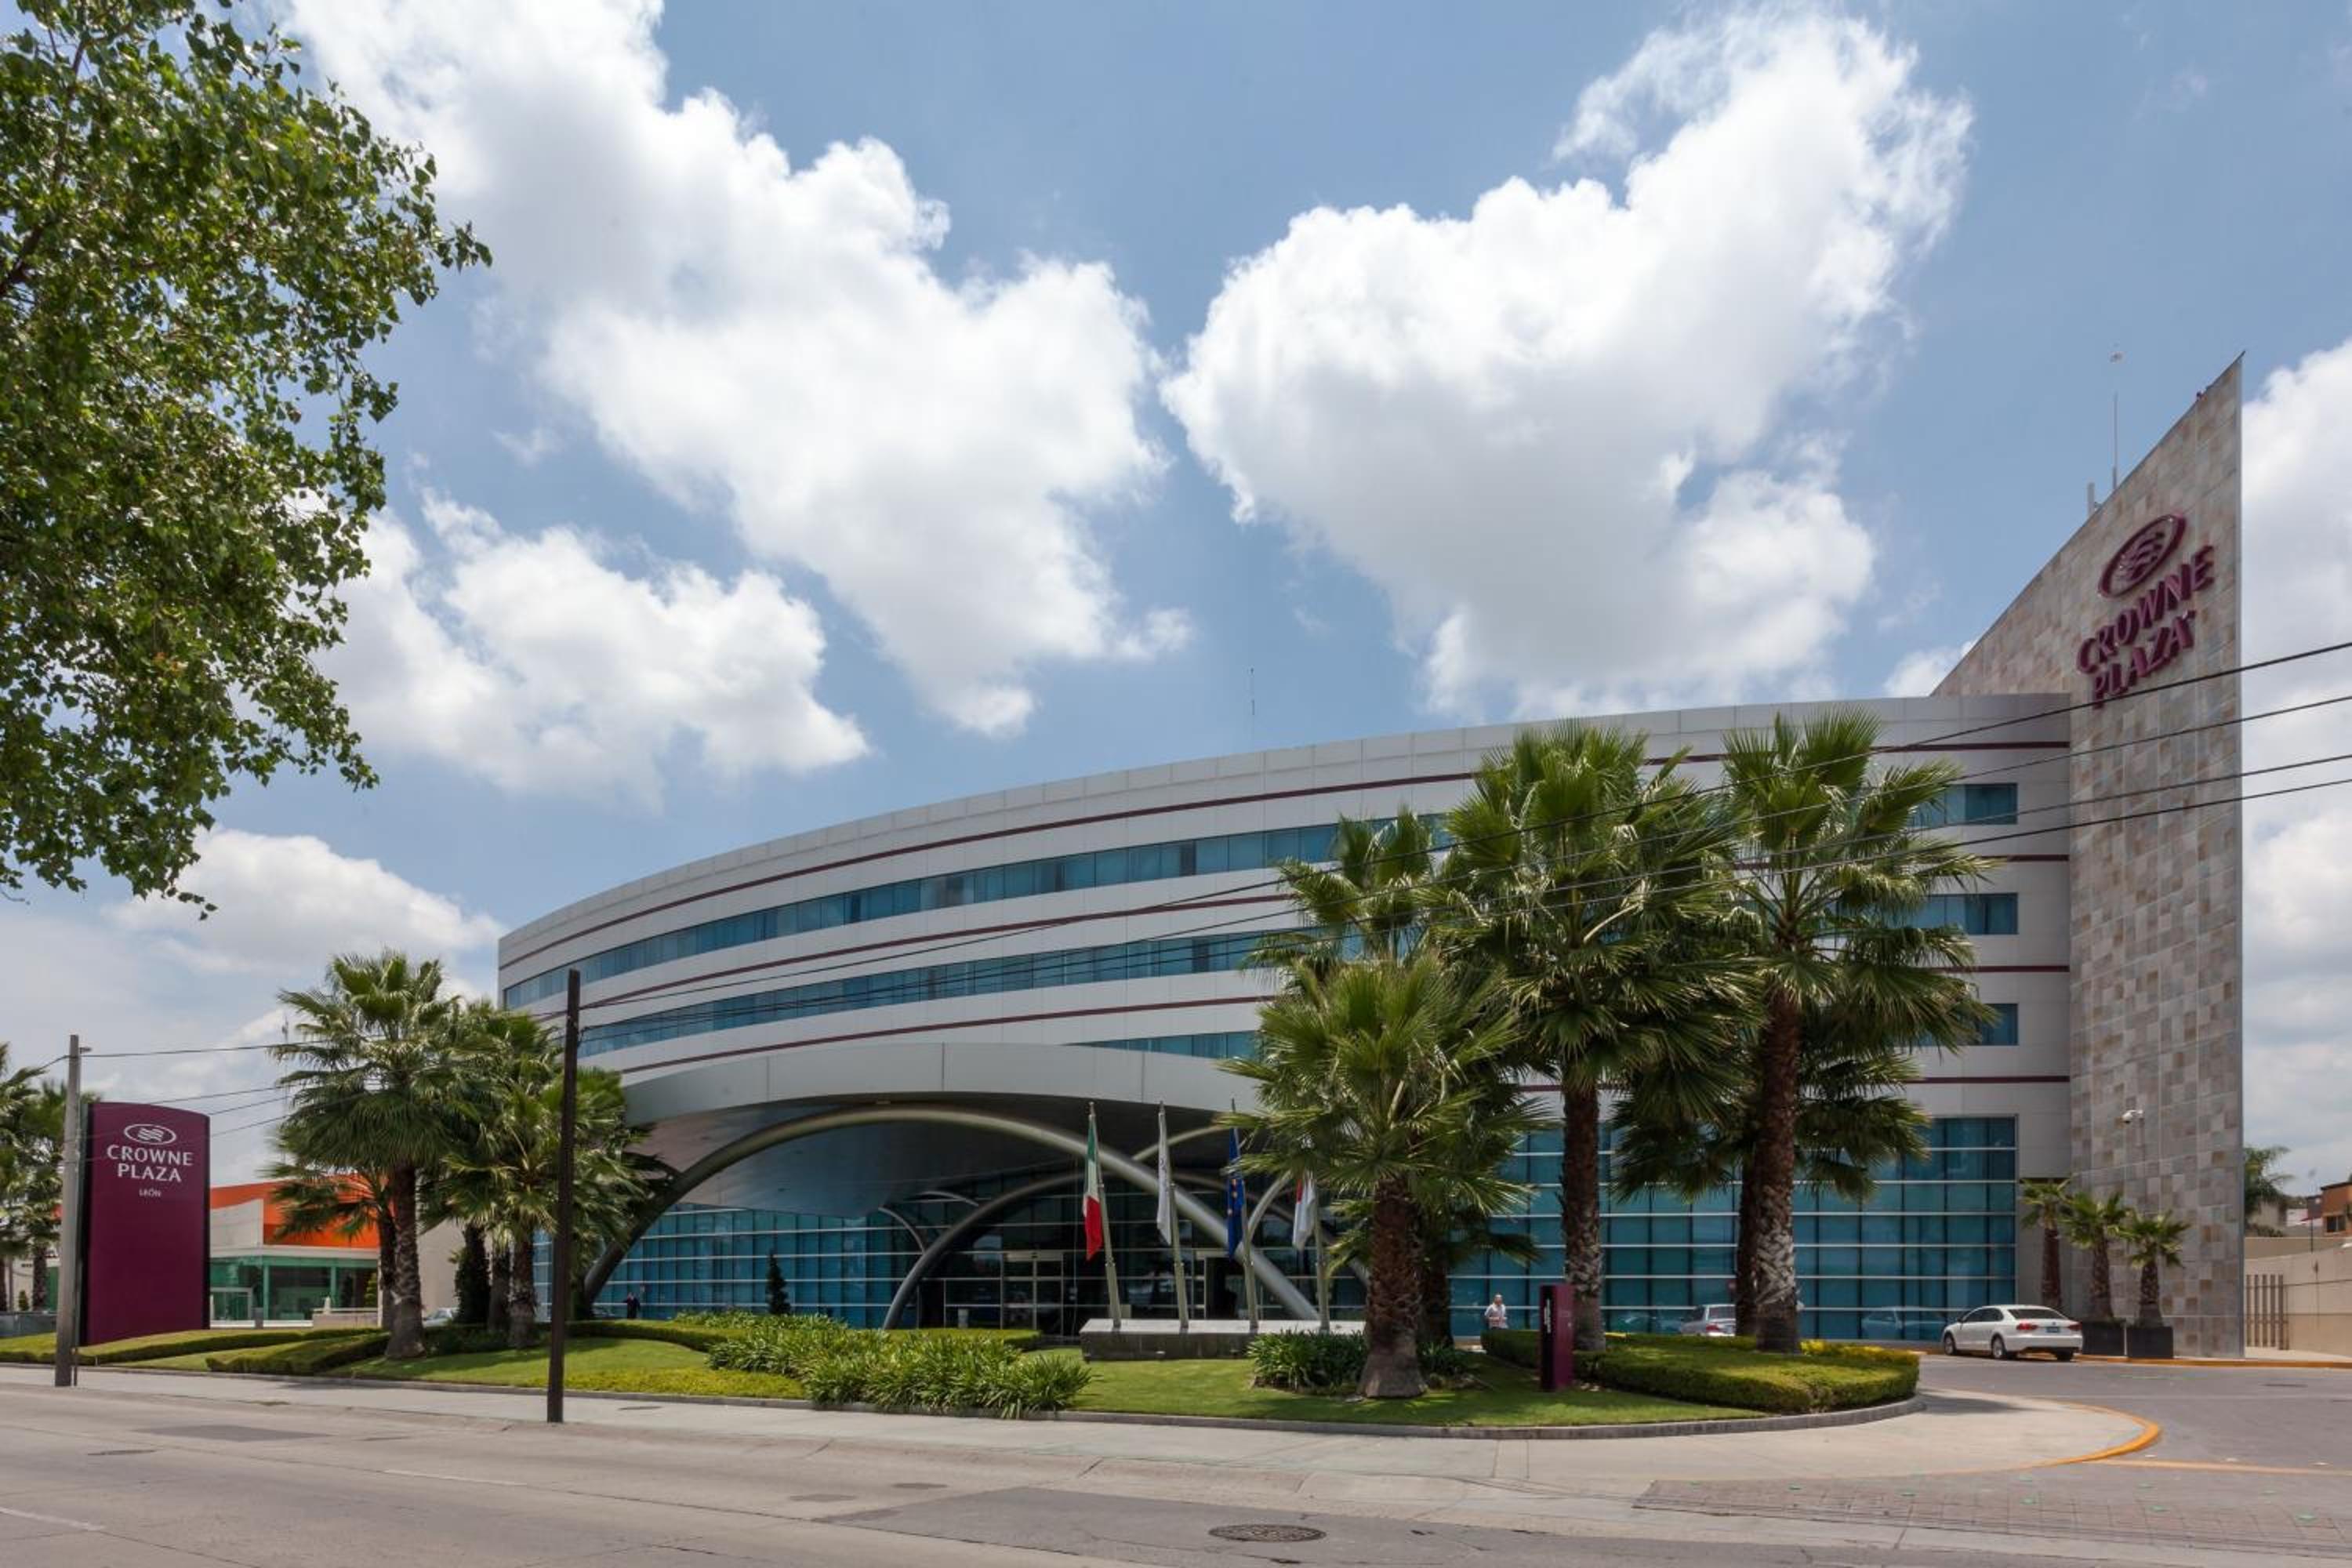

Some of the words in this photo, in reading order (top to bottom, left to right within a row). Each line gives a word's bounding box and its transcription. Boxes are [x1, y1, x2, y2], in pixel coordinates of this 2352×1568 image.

[2078, 545, 2215, 674] CROWNE
[2092, 610, 2196, 709] PLAZA
[107, 1145, 194, 1166] CROWNE
[118, 1163, 182, 1182] PLAZA
